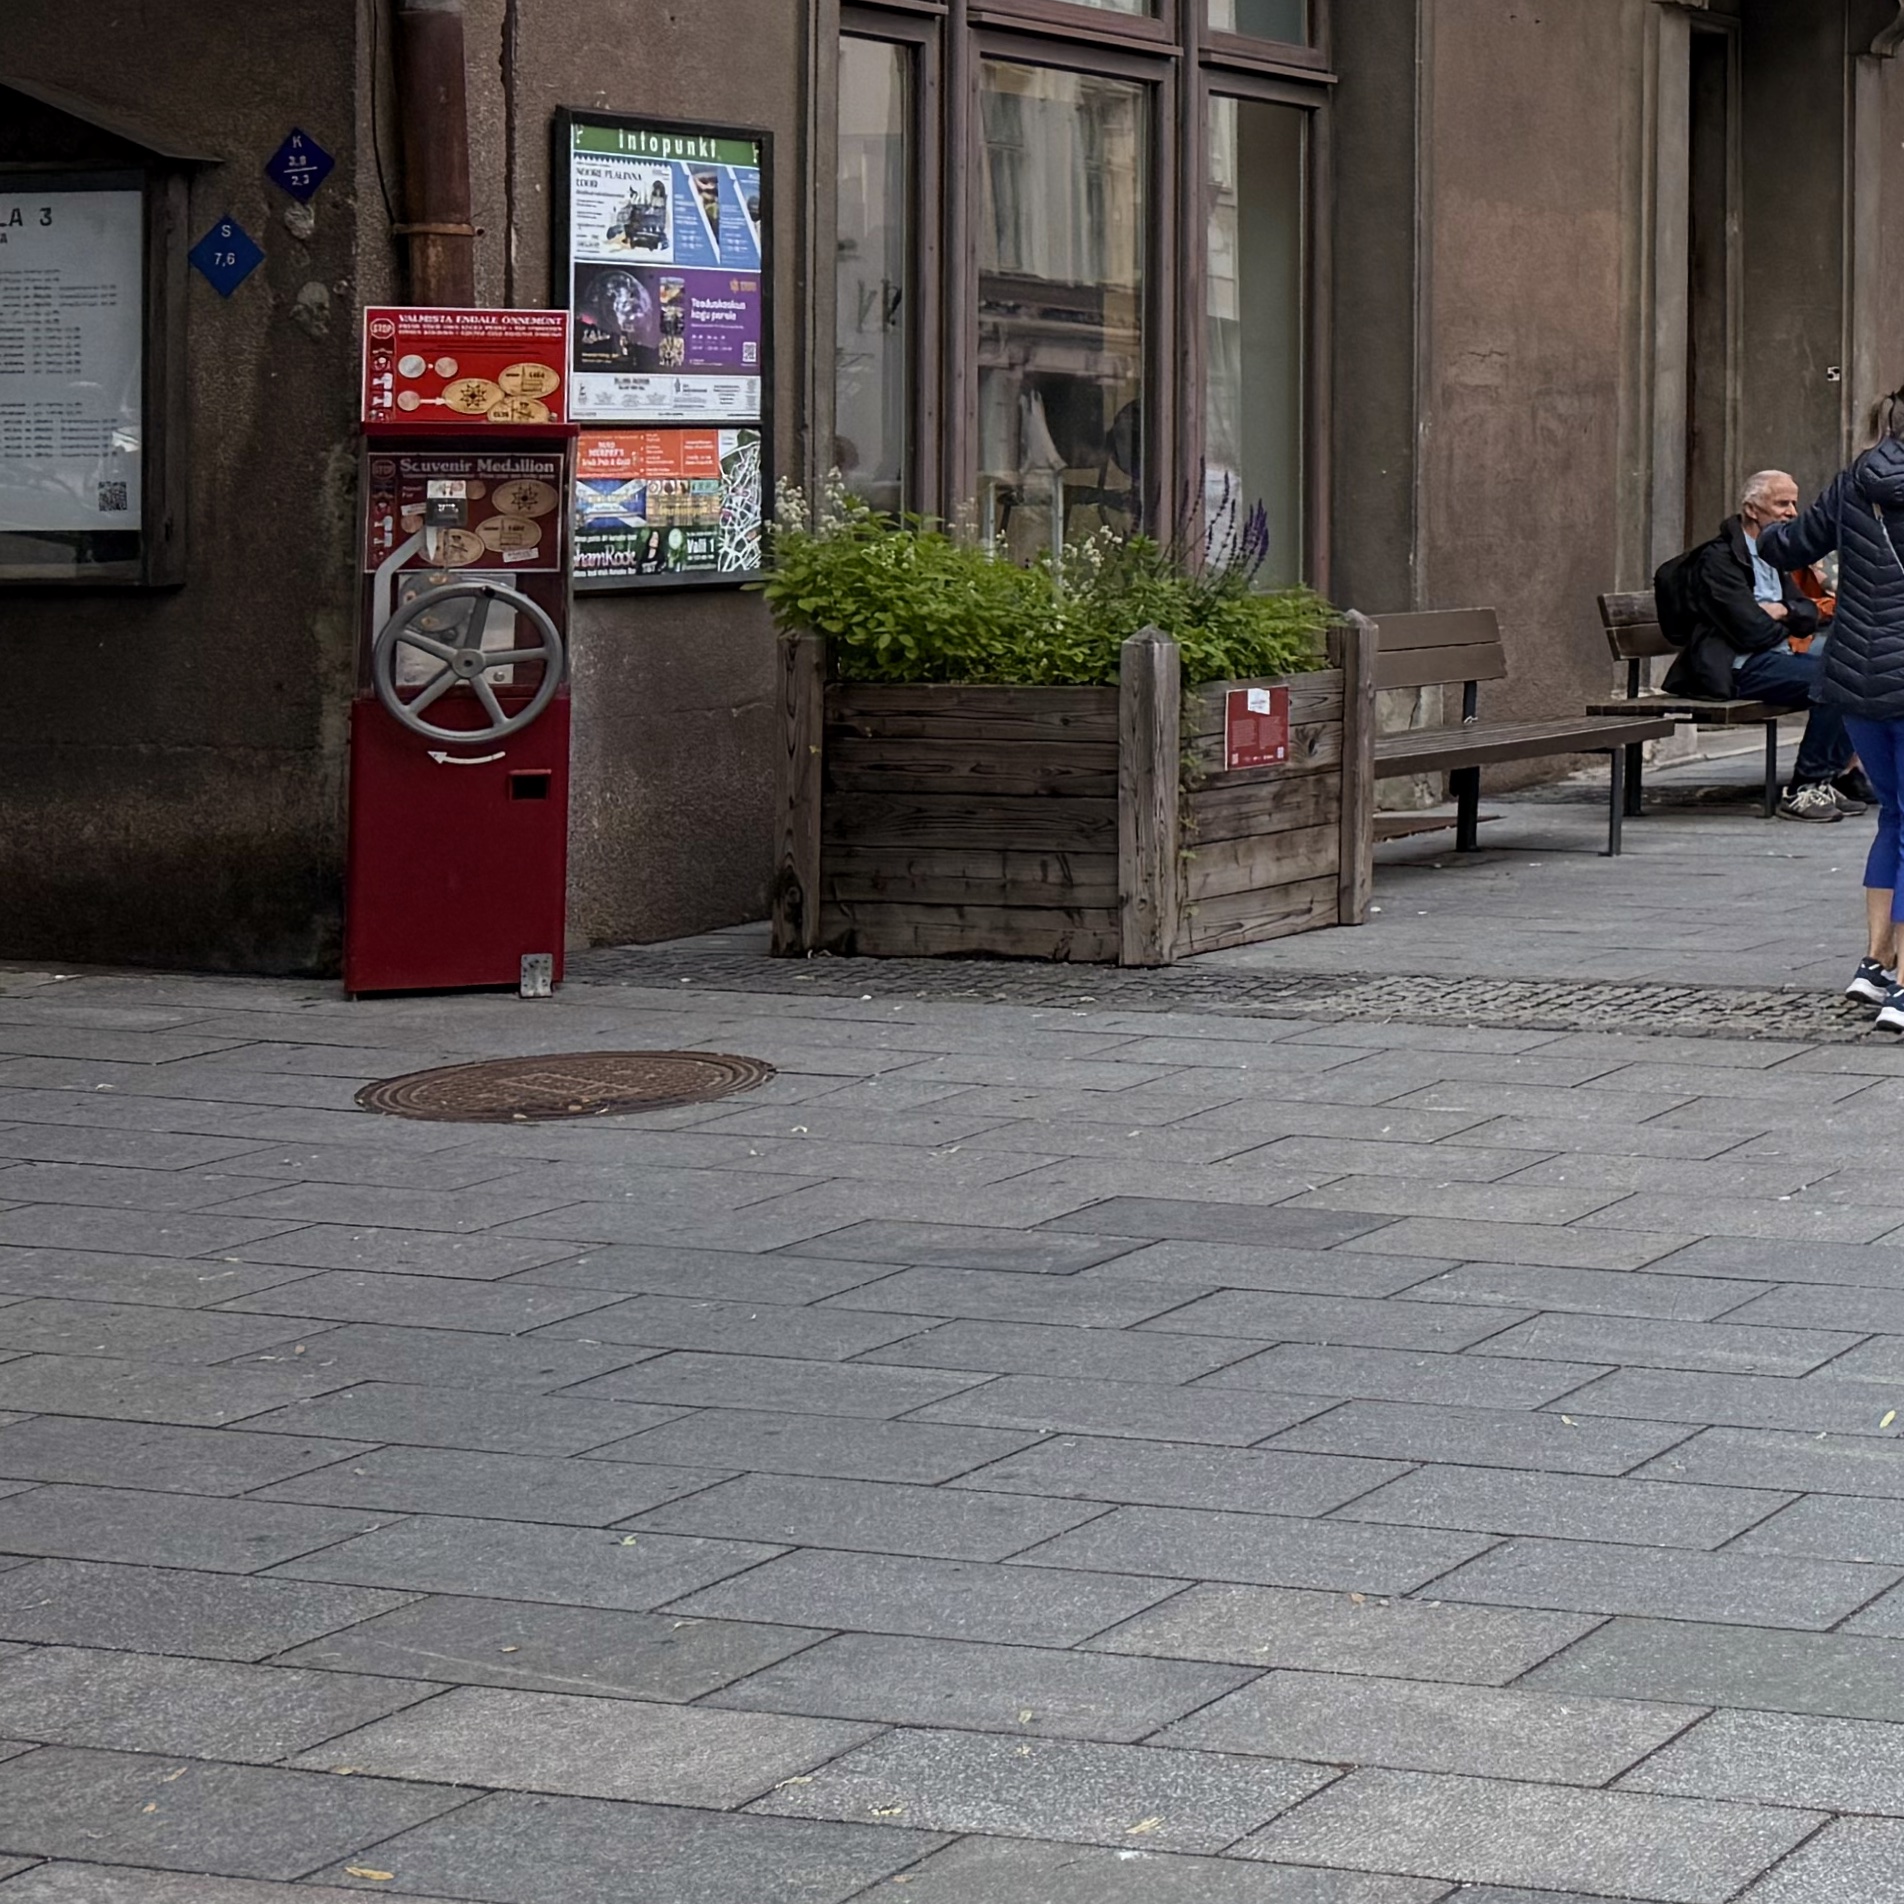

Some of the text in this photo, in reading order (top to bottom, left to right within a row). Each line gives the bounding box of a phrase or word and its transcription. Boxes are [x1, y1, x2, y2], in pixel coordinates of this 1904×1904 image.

[292, 136, 302, 148] K
[39, 207, 53, 226] 3
[221, 225, 231, 237] S
[214, 253, 235, 267] 7,6
[400, 458, 555, 473] Souvenir Medallion
